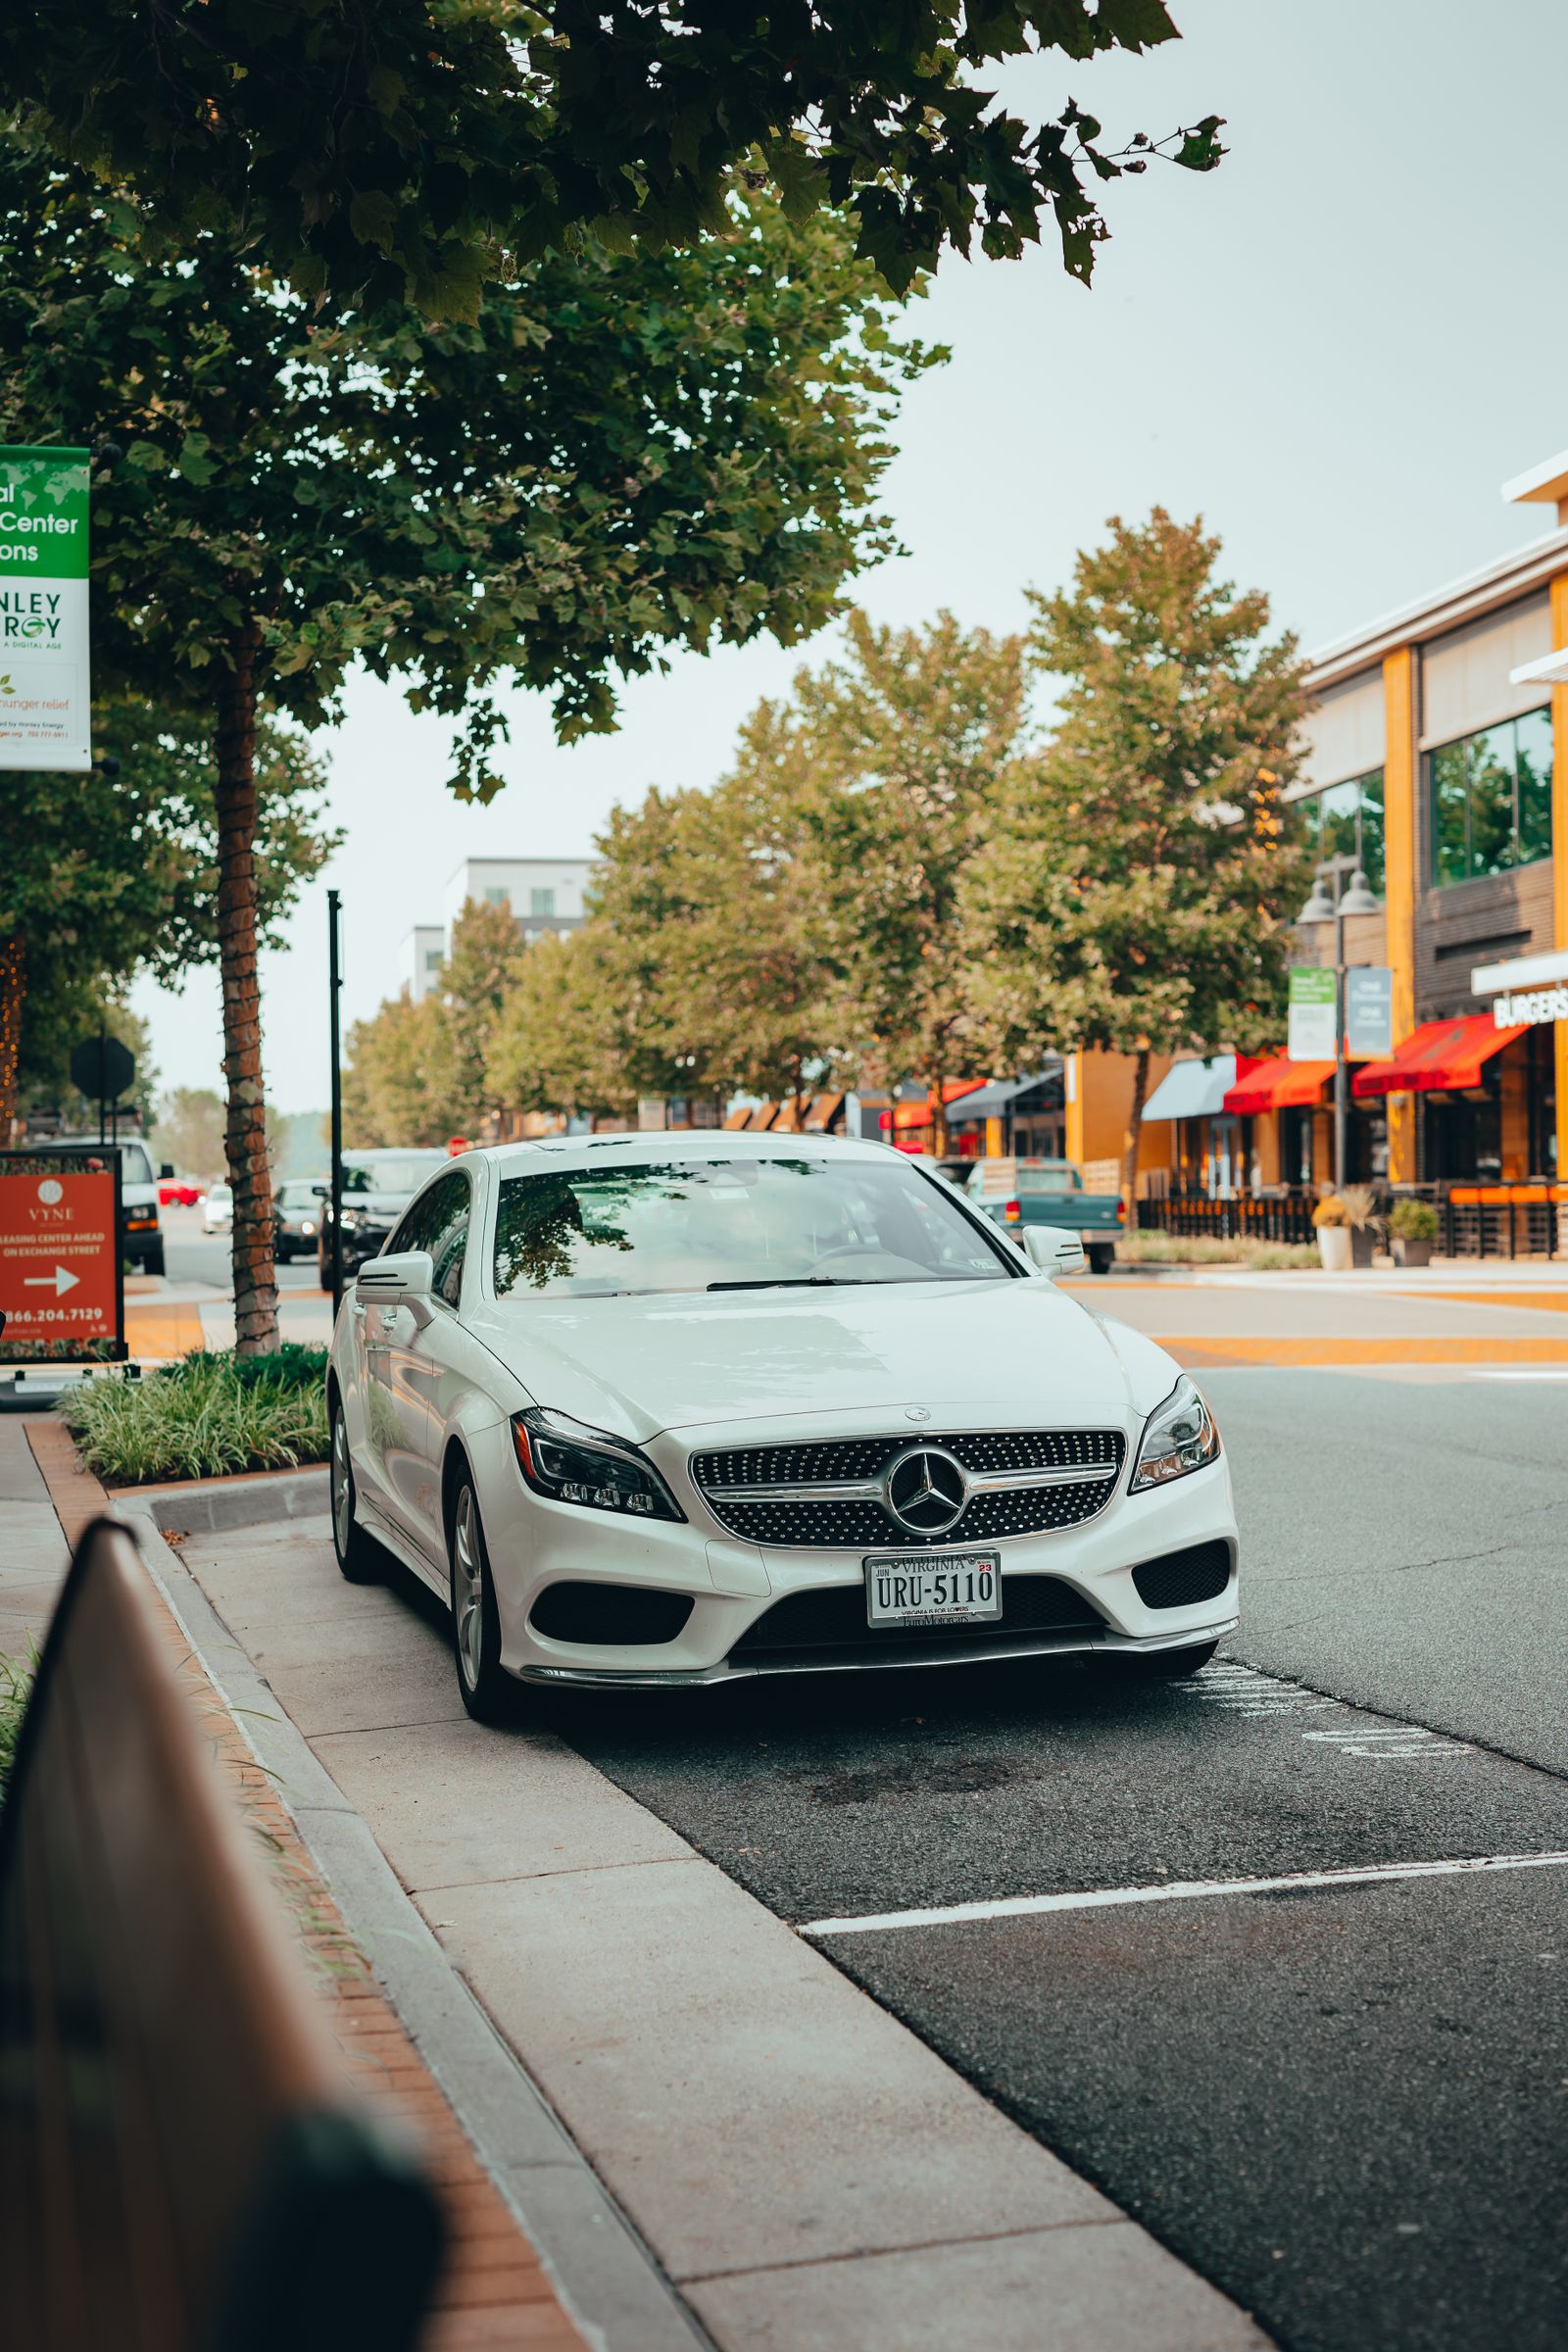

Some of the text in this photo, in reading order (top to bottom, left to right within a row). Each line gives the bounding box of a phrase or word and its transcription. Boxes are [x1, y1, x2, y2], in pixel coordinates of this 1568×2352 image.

[0, 511, 78, 534] Center
[0, 544, 39, 562] ons
[28, 1206, 74, 1221] VYNE
[0, 1232, 105, 1245] LEASING CENTER AHEAD
[3, 1245, 101, 1256] ON EXCHANGE STREET
[875, 1568, 890, 1578] JUN
[903, 1559, 965, 1573] VIRGINIA
[877, 1572, 993, 1608] URU-5110
[904, 1615, 969, 1627] EuroMotorcars
